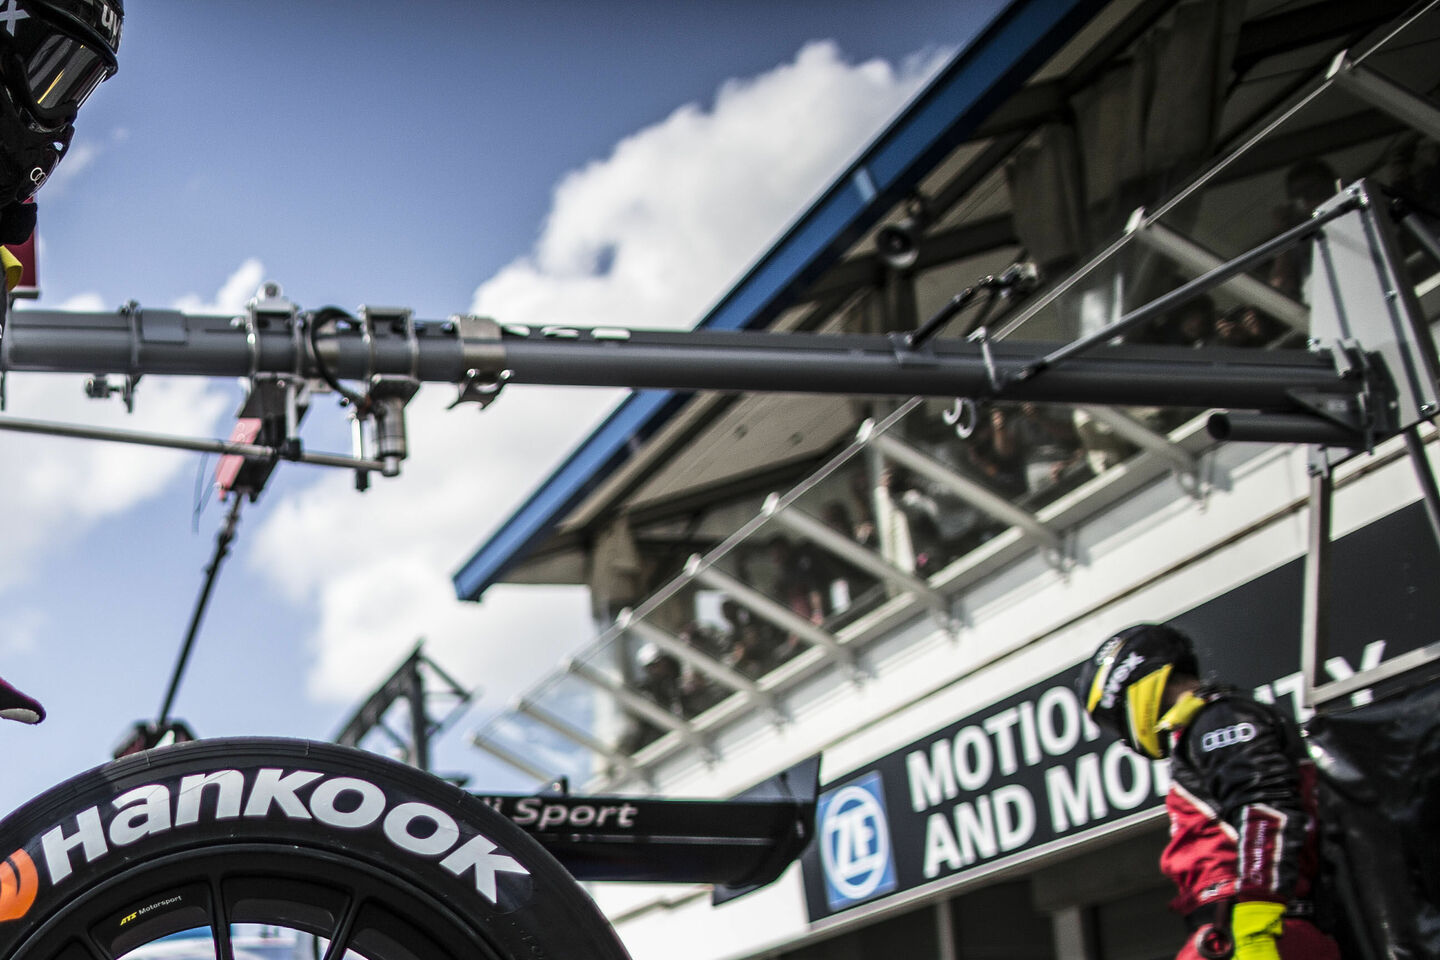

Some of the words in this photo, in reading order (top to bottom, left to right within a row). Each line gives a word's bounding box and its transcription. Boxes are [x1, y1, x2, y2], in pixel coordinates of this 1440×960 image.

[40, 767, 532, 904] Hankook
[512, 797, 639, 832] Sport
[824, 801, 877, 877] ZF
[923, 784, 1037, 879] AND
[119, 911, 138, 926] ATS
[138, 895, 183, 916] Motorsport
